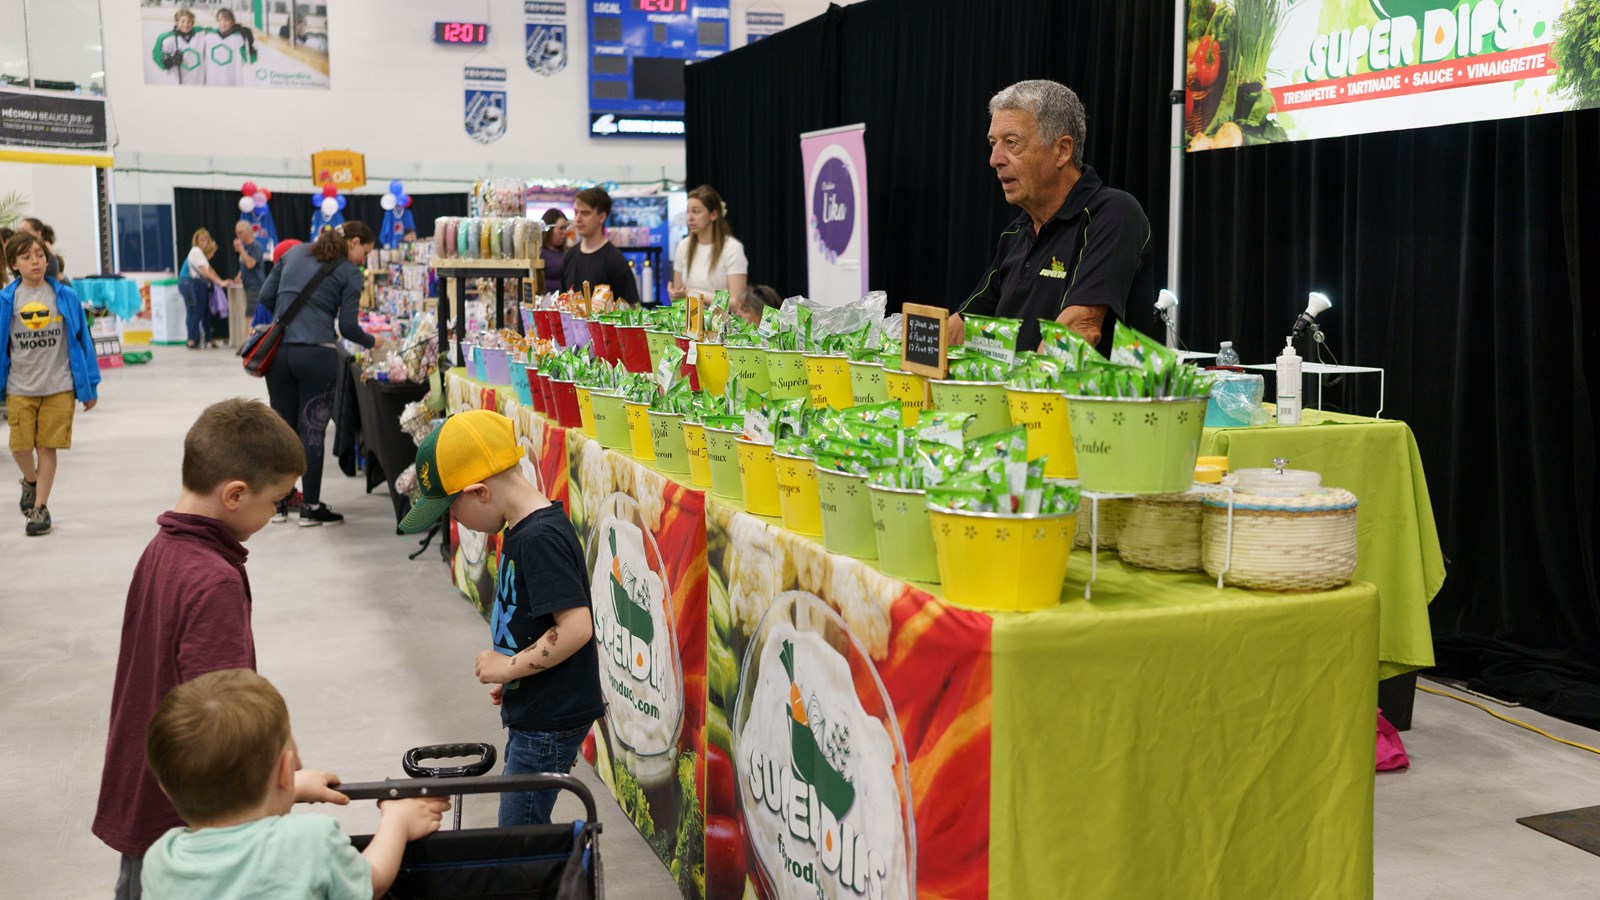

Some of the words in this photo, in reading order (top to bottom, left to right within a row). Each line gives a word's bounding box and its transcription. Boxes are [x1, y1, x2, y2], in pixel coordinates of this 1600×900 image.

[593, 3, 621, 14] LOCAL
[444, 23, 485, 43] 12:01
[1305, 15, 1417, 82] SUPER
[1420, 0, 1523, 64] DIPS
[1283, 85, 1336, 105] TREMPETTE
[1347, 75, 1401, 96] TARTINADE
[1412, 67, 1454, 86] SAUCE
[1466, 53, 1546, 79] VINAIGRETTE
[823, 192, 847, 223] Lika
[14, 328, 61, 340] WEEKEND
[20, 338, 57, 350] MOOD
[778, 377, 808, 391] Suprêm
[1075, 434, 1111, 455] Érable
